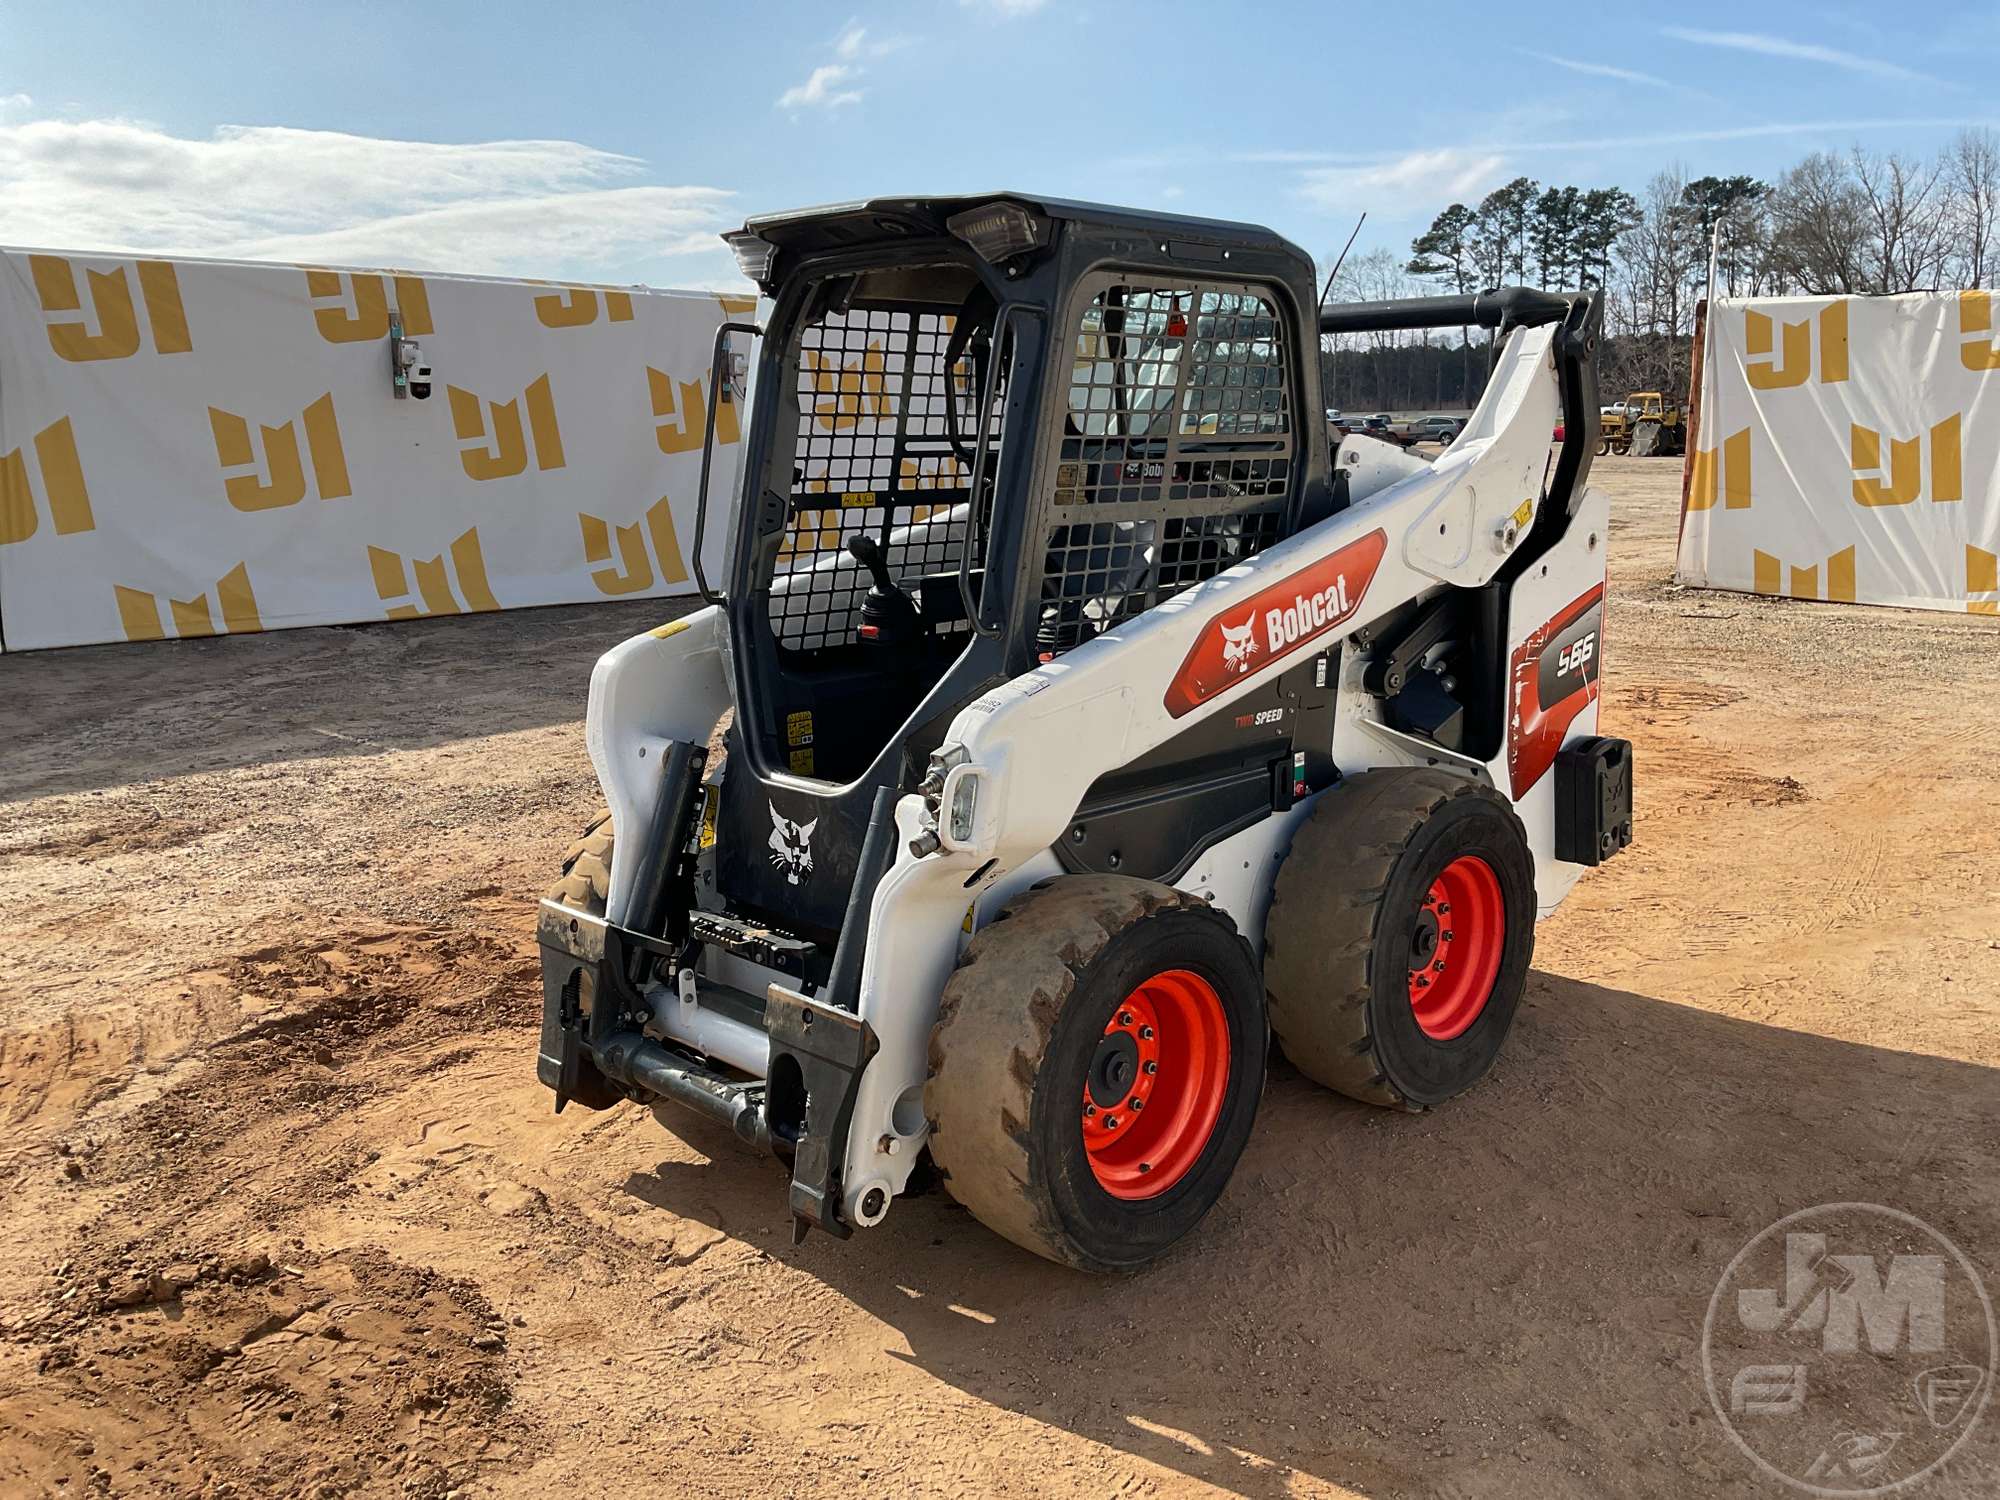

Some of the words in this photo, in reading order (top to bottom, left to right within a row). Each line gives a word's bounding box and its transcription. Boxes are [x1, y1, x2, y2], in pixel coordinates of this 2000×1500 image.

[1265, 573, 1348, 653] Bobcat
[1557, 631, 1595, 678] S66
[1254, 708, 1283, 726] SPEED
